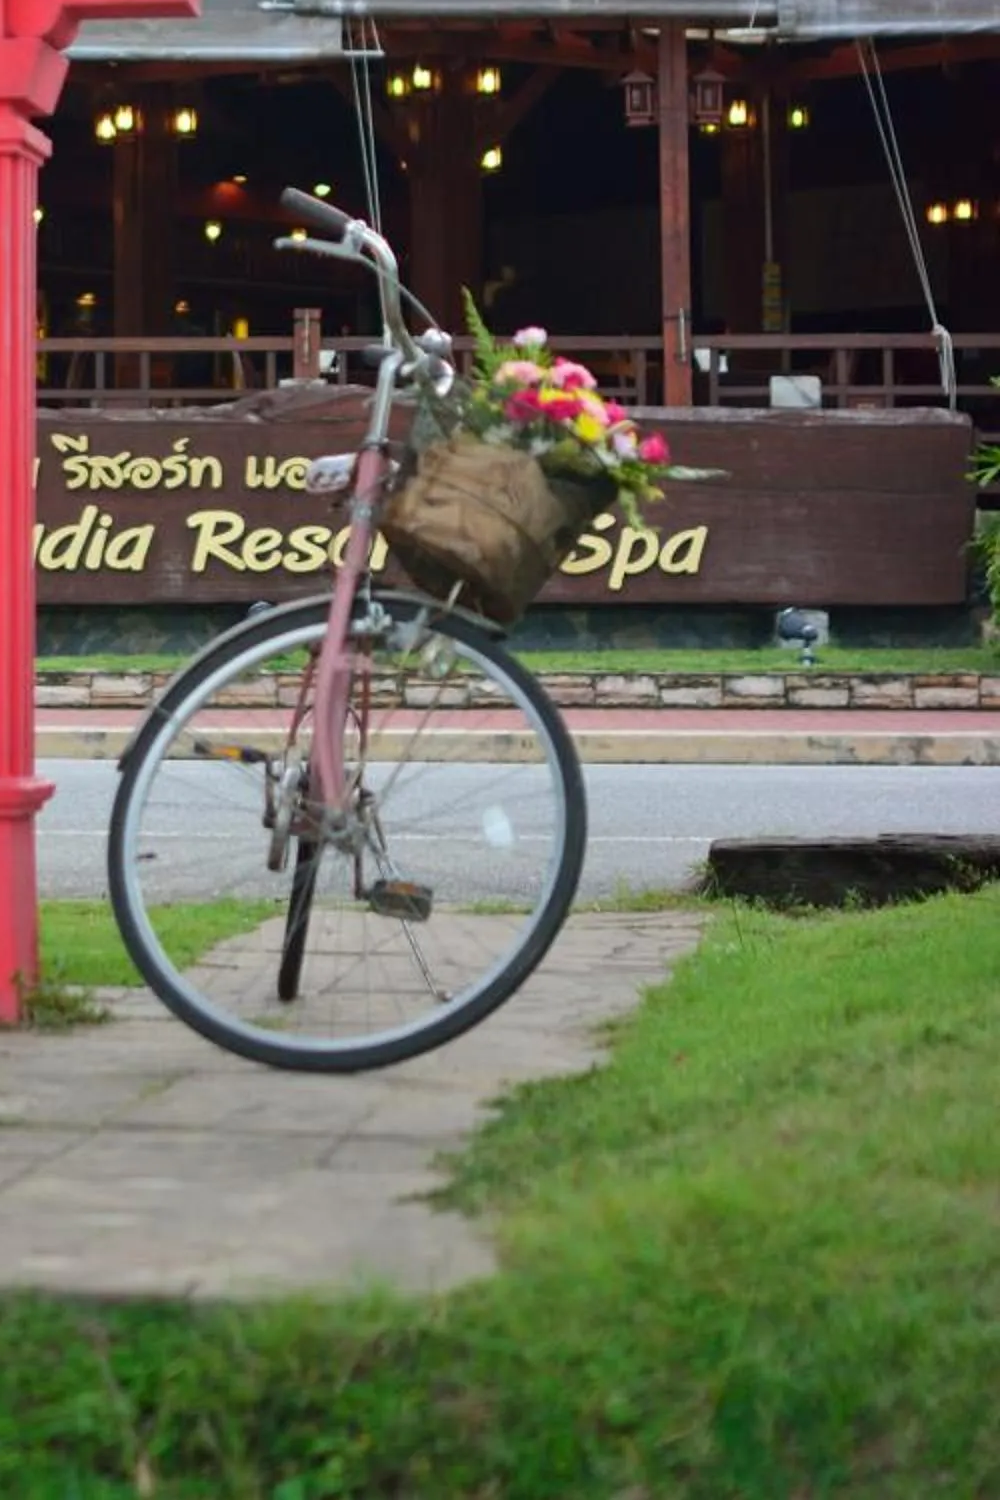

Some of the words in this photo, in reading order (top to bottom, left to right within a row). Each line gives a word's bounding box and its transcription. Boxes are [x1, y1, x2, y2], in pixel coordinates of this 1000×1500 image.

[51, 433, 223, 490] รีสอร์ท
[558, 512, 708, 590] Spa
